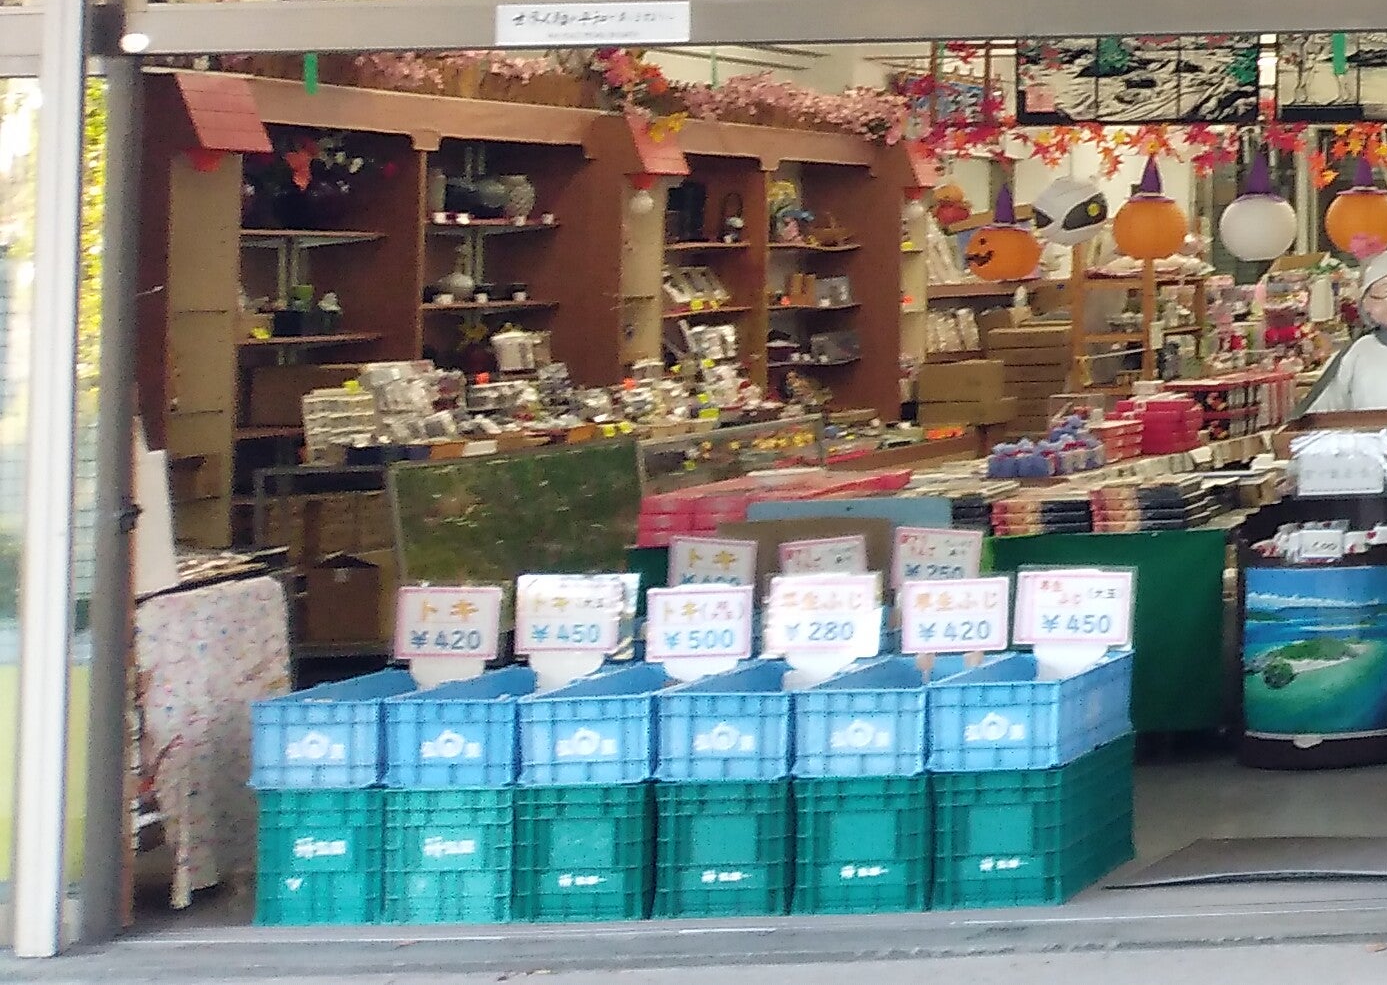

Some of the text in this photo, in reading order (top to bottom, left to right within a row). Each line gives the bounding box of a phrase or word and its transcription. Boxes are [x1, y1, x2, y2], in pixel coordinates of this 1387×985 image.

[420, 599, 480, 623] トキ
[530, 623, 601, 644] ¥450
[917, 619, 992, 642] ¥420
[1040, 613, 1112, 635] ¥450
[409, 628, 483, 650] ¥420
[663, 627, 735, 650] ¥500
